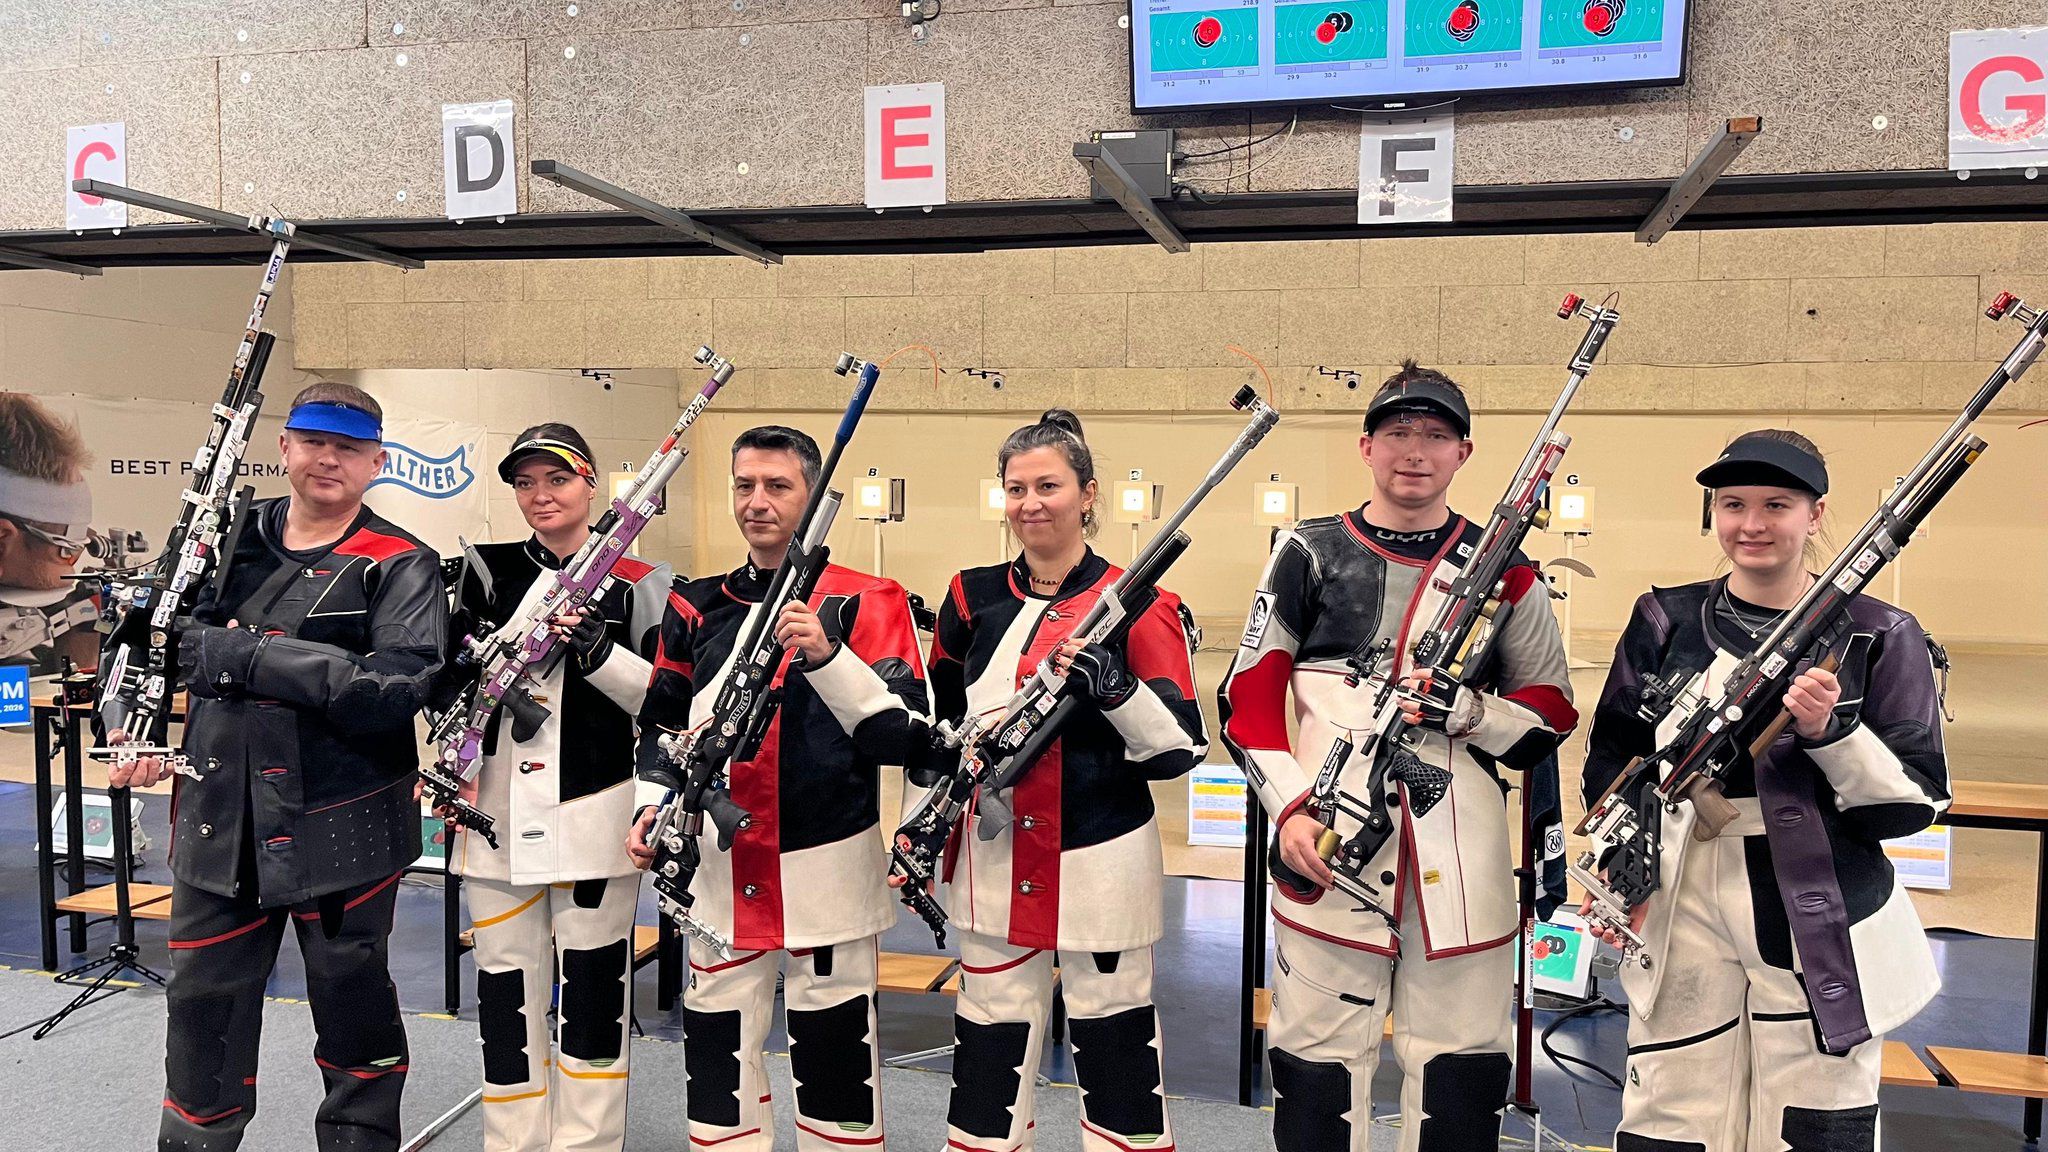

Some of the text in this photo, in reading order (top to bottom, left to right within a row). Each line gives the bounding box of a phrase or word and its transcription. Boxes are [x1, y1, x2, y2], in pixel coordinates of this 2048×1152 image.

[1959, 56, 2046, 144] G
[881, 105, 933, 180] E
[74, 142, 117, 206] C
[455, 125, 505, 193] D
[1379, 138, 1435, 216] F
[267, 257, 282, 284] LAPUA
[111, 460, 171, 475] BEST
[383, 452, 456, 489] ALTHER
[623, 463, 633, 472] R1
[868, 468, 877, 476] B
[1567, 475, 1578, 485] G
[4, 704, 24, 712] 2026
